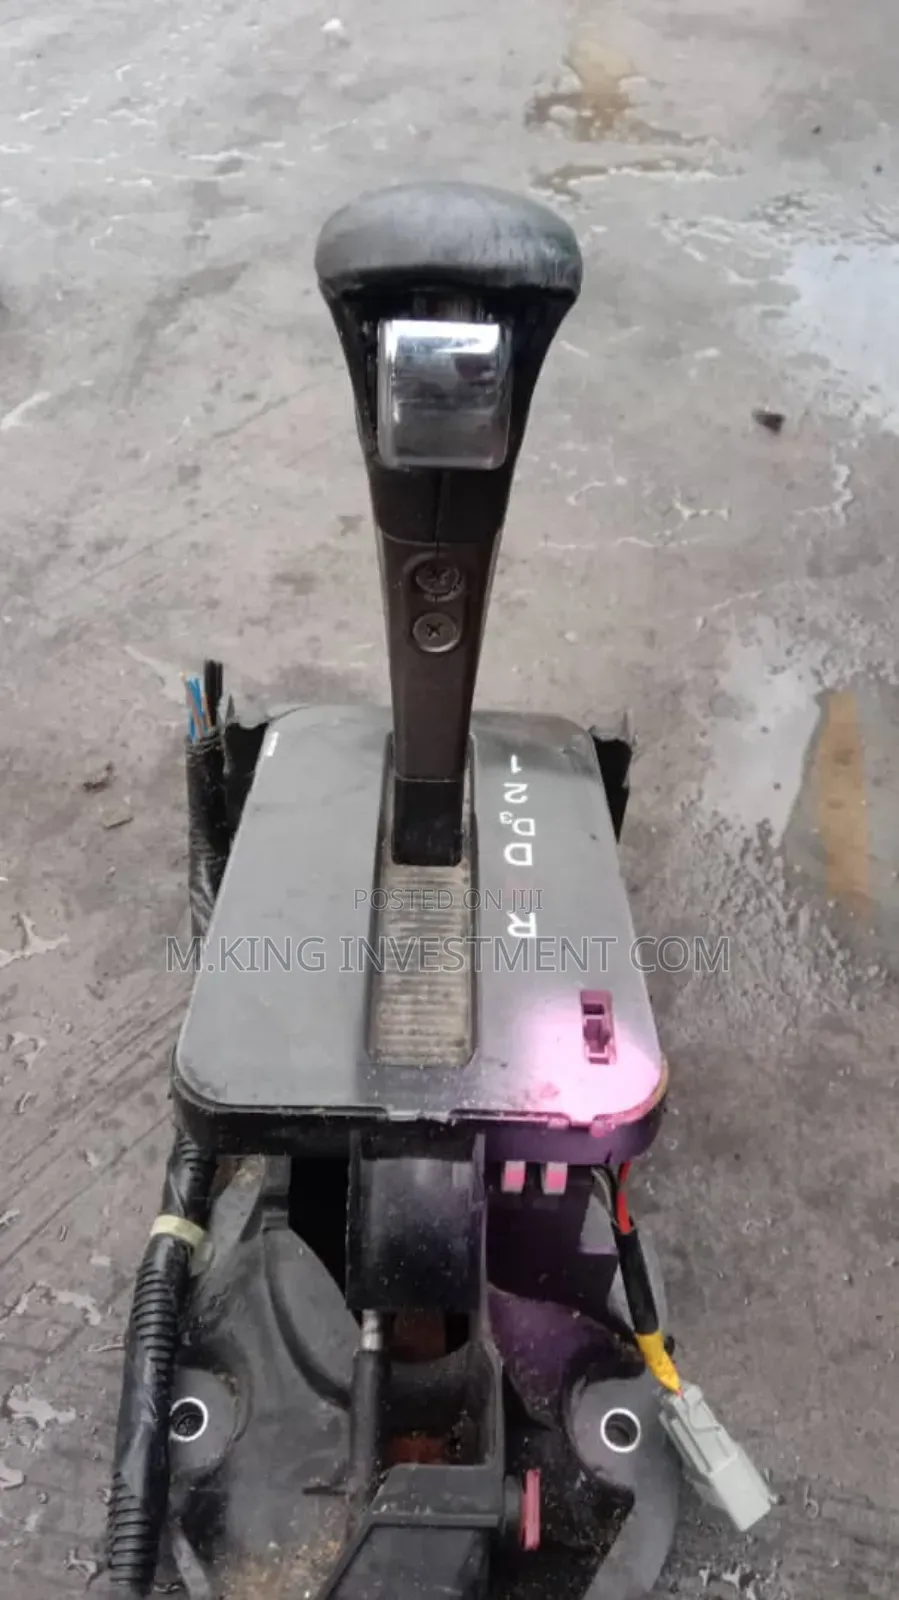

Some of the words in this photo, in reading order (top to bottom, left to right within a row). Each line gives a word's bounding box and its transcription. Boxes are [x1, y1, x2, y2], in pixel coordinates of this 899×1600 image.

[503, 782, 528, 804] 2
[504, 843, 533, 866] D
[507, 912, 536, 938] R
